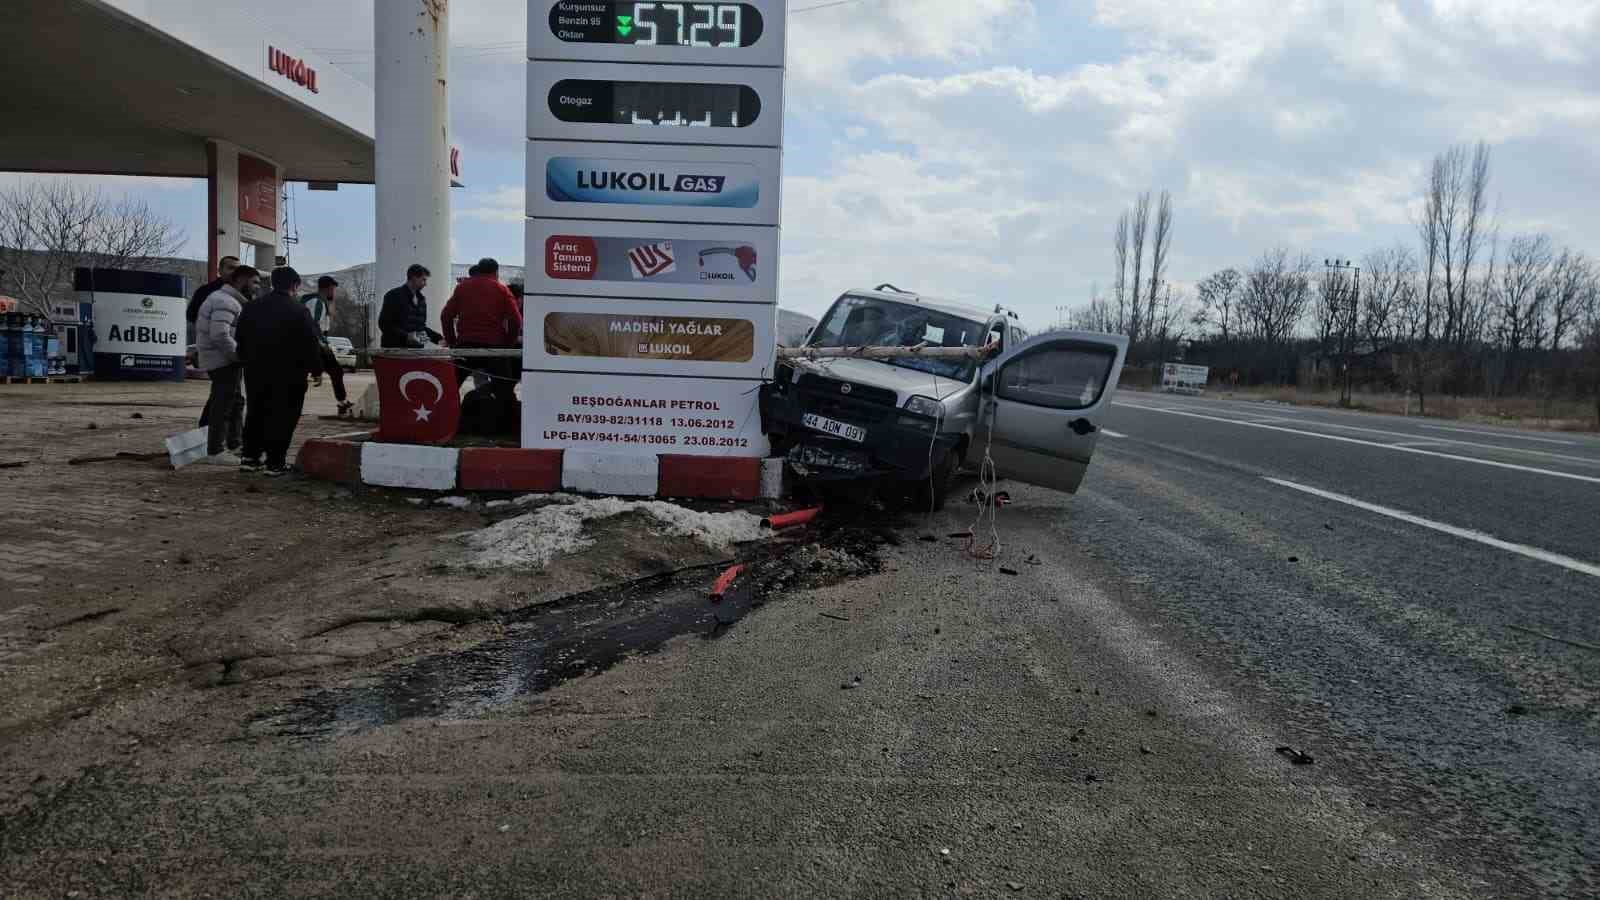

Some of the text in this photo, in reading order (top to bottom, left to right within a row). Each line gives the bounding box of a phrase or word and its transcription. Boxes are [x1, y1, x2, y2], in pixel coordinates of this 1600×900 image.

[558, 2, 606, 13] Kurşunsuz
[558, 16, 601, 26] Benzin 95
[634, 3, 741, 47] 57.29
[558, 30, 585, 39] Oktan
[268, 45, 319, 94] LUKOIL
[559, 95, 593, 107] Otogaz
[576, 170, 718, 192] LUKOIL GAS
[553, 241, 579, 254] Araç
[553, 262, 591, 273] Sistemi
[108, 324, 177, 345] AdBlue
[609, 320, 723, 336] MADENİ YAĞLAR
[649, 343, 693, 355] LUKOIL
[571, 395, 721, 411] BEŞDOĞANLAR PETROL
[670, 417, 736, 430] 13.06.2012
[805, 415, 818, 427] 44
[845, 426, 864, 441] 091
[683, 435, 749, 448] 23.08.2012
